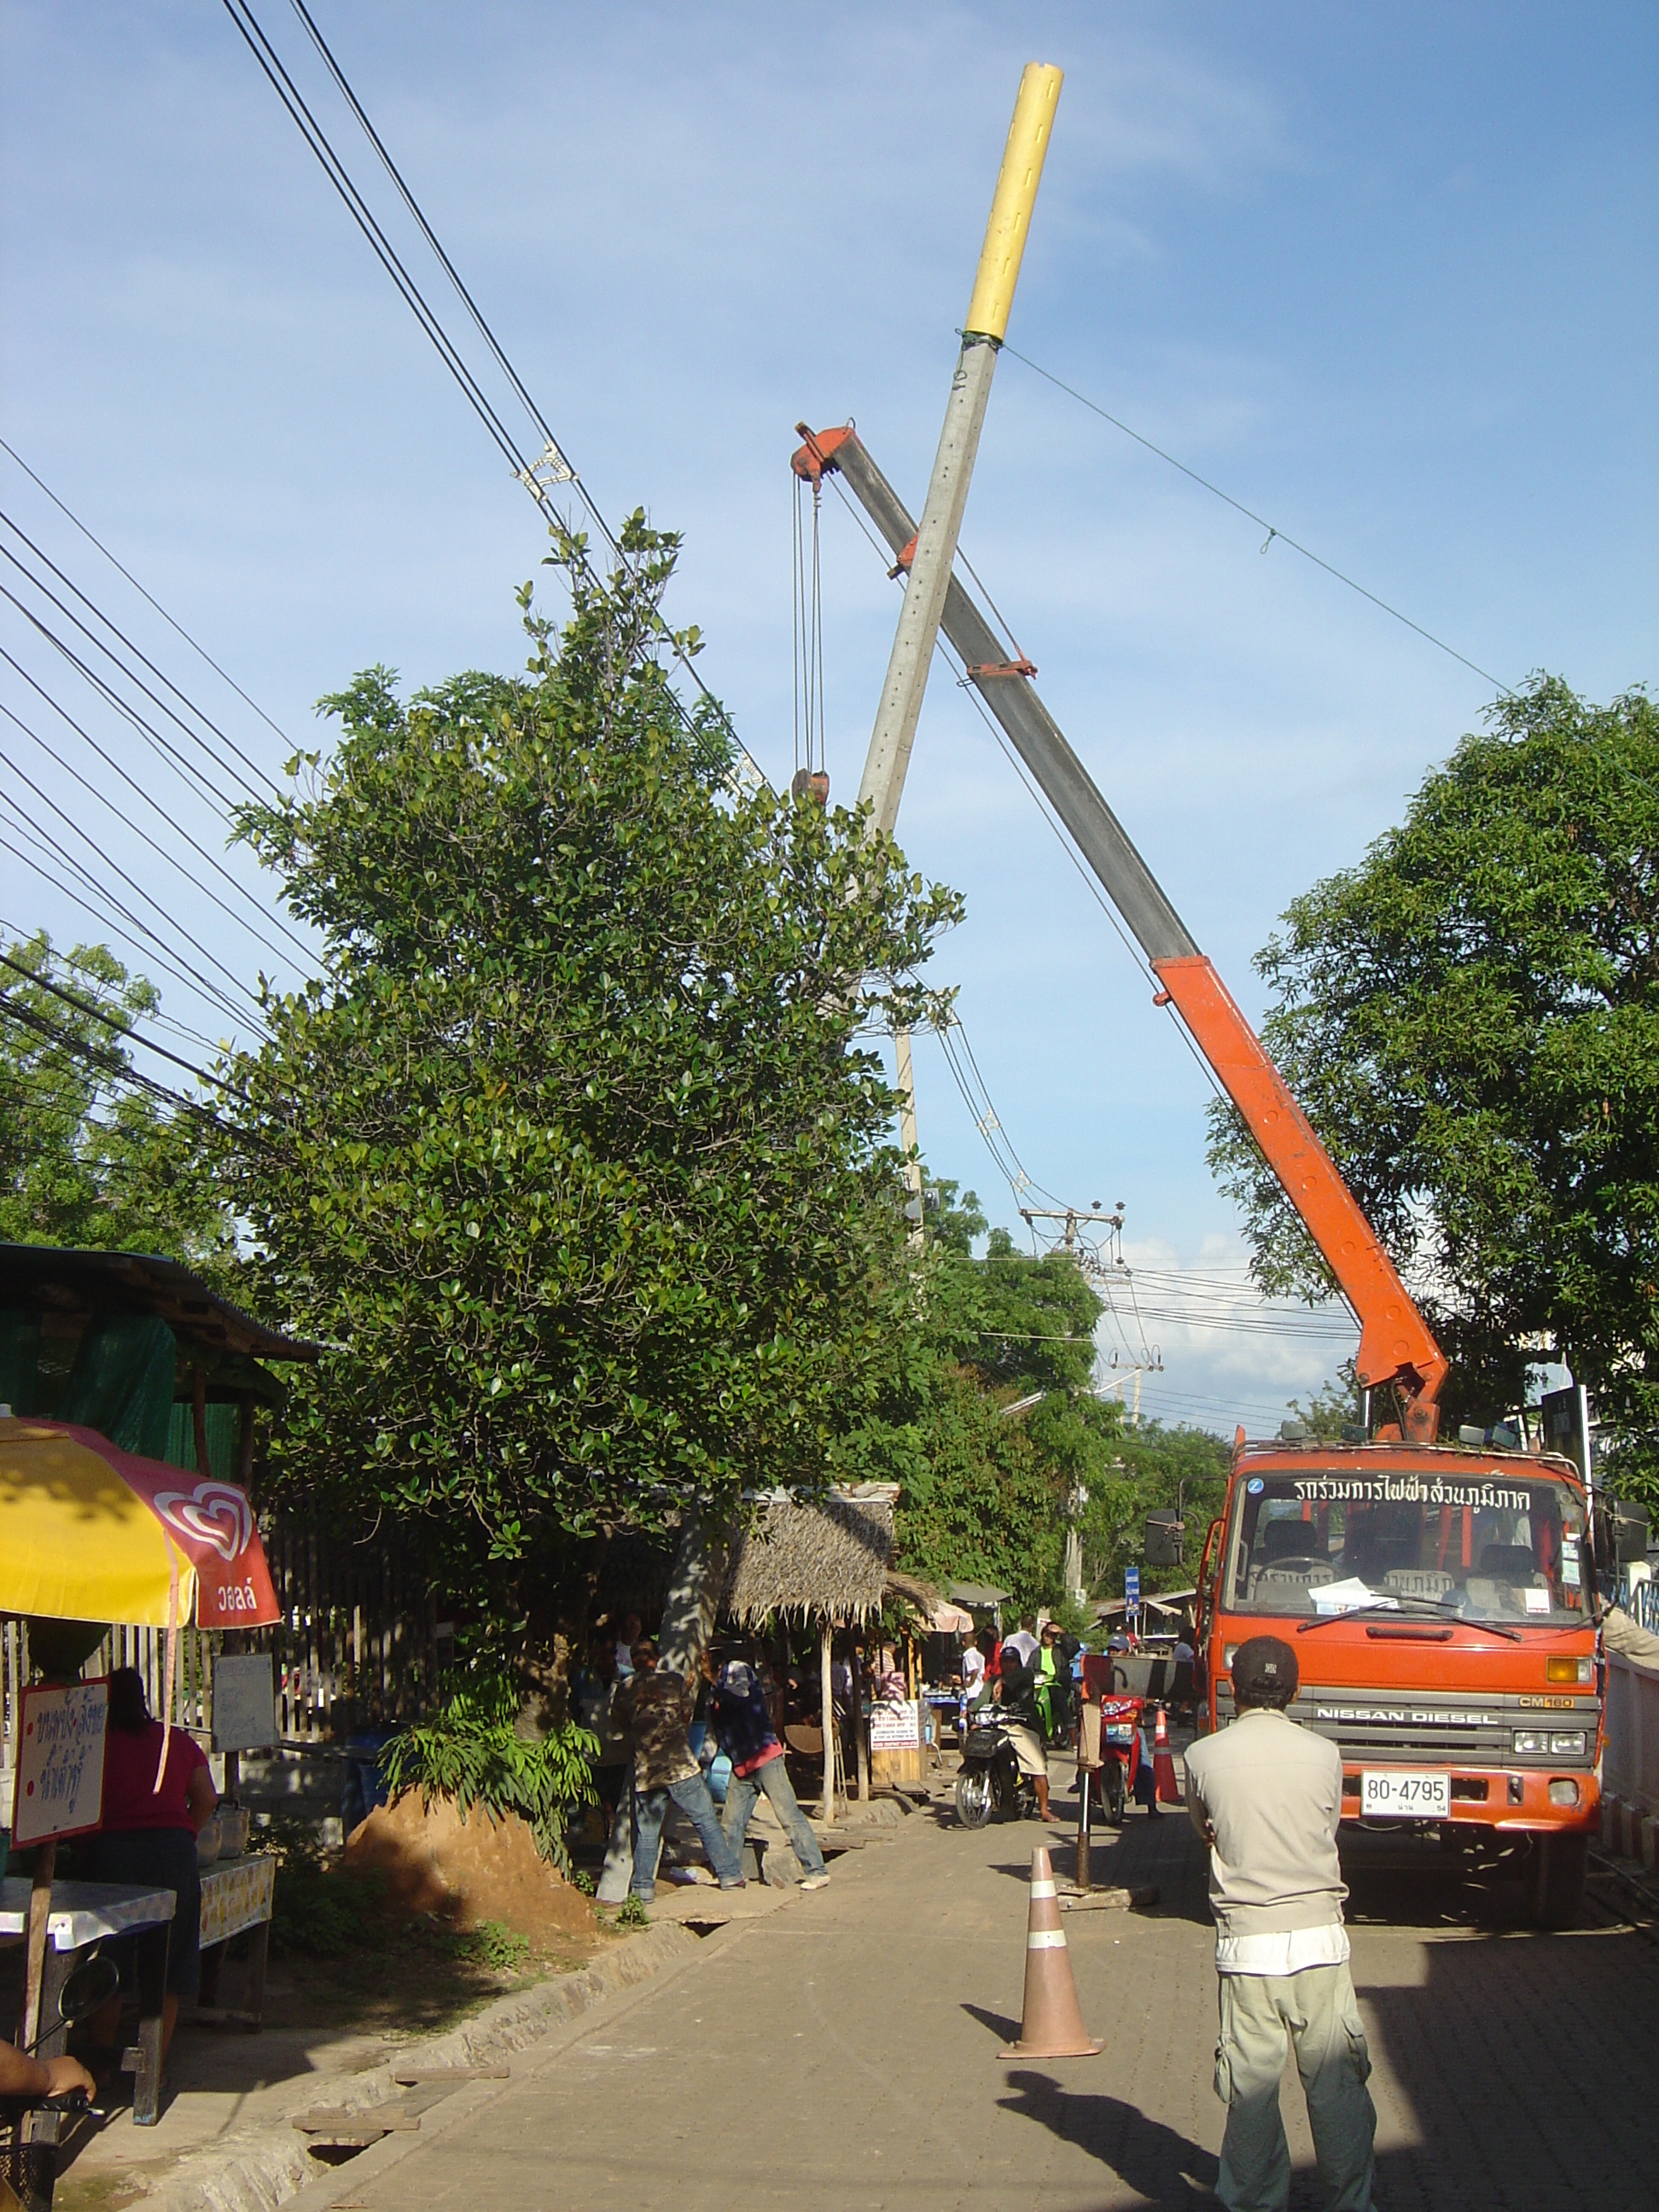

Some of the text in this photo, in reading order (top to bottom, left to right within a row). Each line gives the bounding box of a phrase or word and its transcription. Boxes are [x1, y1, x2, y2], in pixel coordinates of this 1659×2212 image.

[218, 1576, 258, 1611] วอลล์
[1317, 1708, 1499, 1725] NISSAN DIESEL
[1367, 1778, 1445, 1802] 80-4795
